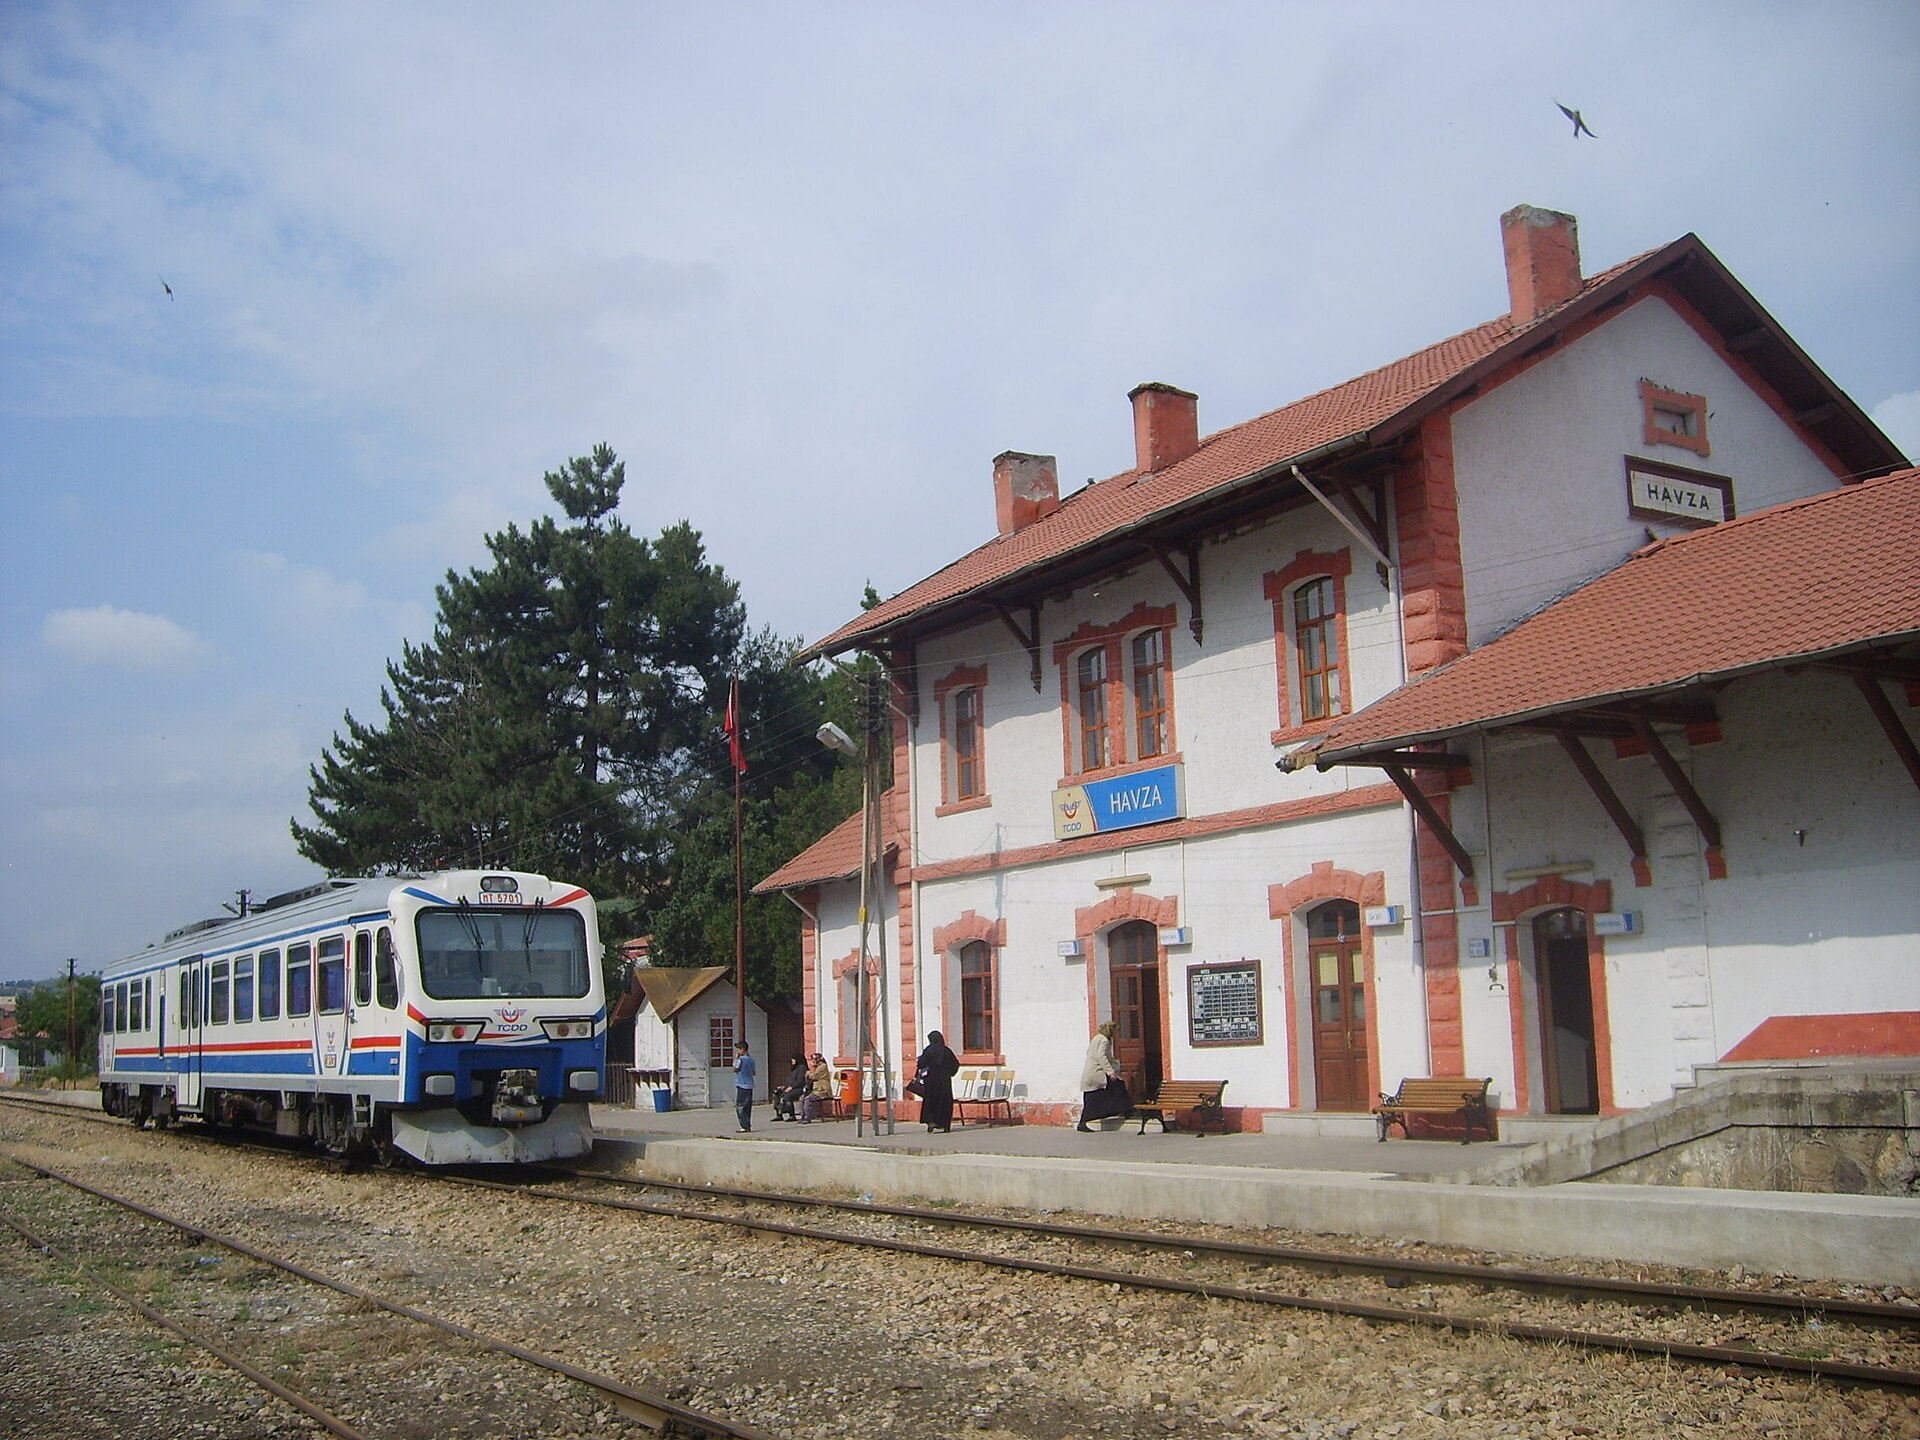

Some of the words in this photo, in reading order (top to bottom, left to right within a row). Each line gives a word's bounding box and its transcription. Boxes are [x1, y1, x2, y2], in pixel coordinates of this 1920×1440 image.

[1647, 483, 1709, 510] HAVZA
[1110, 784, 1163, 814] HAVZA
[1063, 821, 1082, 833] TCDD
[483, 893, 493, 903] MT
[497, 893, 519, 903] 5701
[497, 1024, 528, 1032] TCDD
